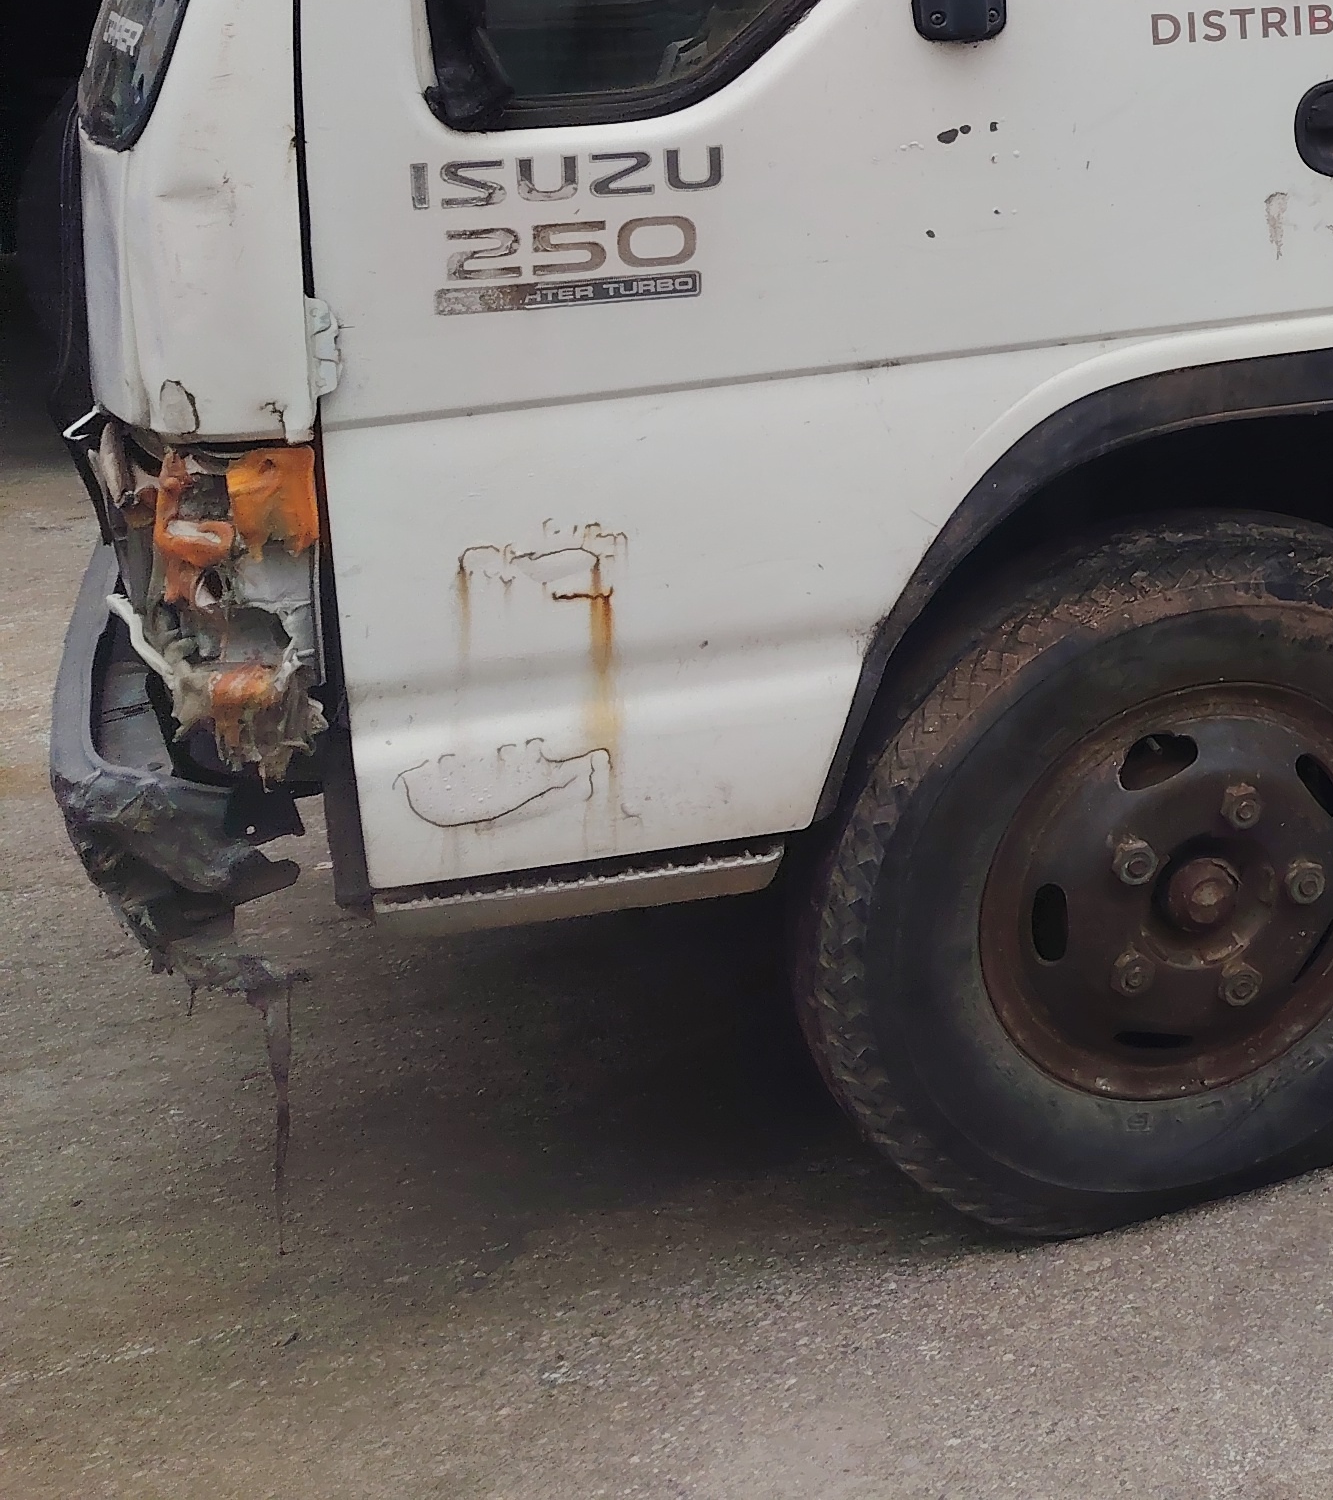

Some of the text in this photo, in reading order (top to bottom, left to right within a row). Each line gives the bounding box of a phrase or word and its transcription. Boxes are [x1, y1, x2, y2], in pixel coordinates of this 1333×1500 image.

[410, 144, 724, 211] ISUZU
[446, 215, 697, 282] 250
[602, 277, 693, 296] TURBO
